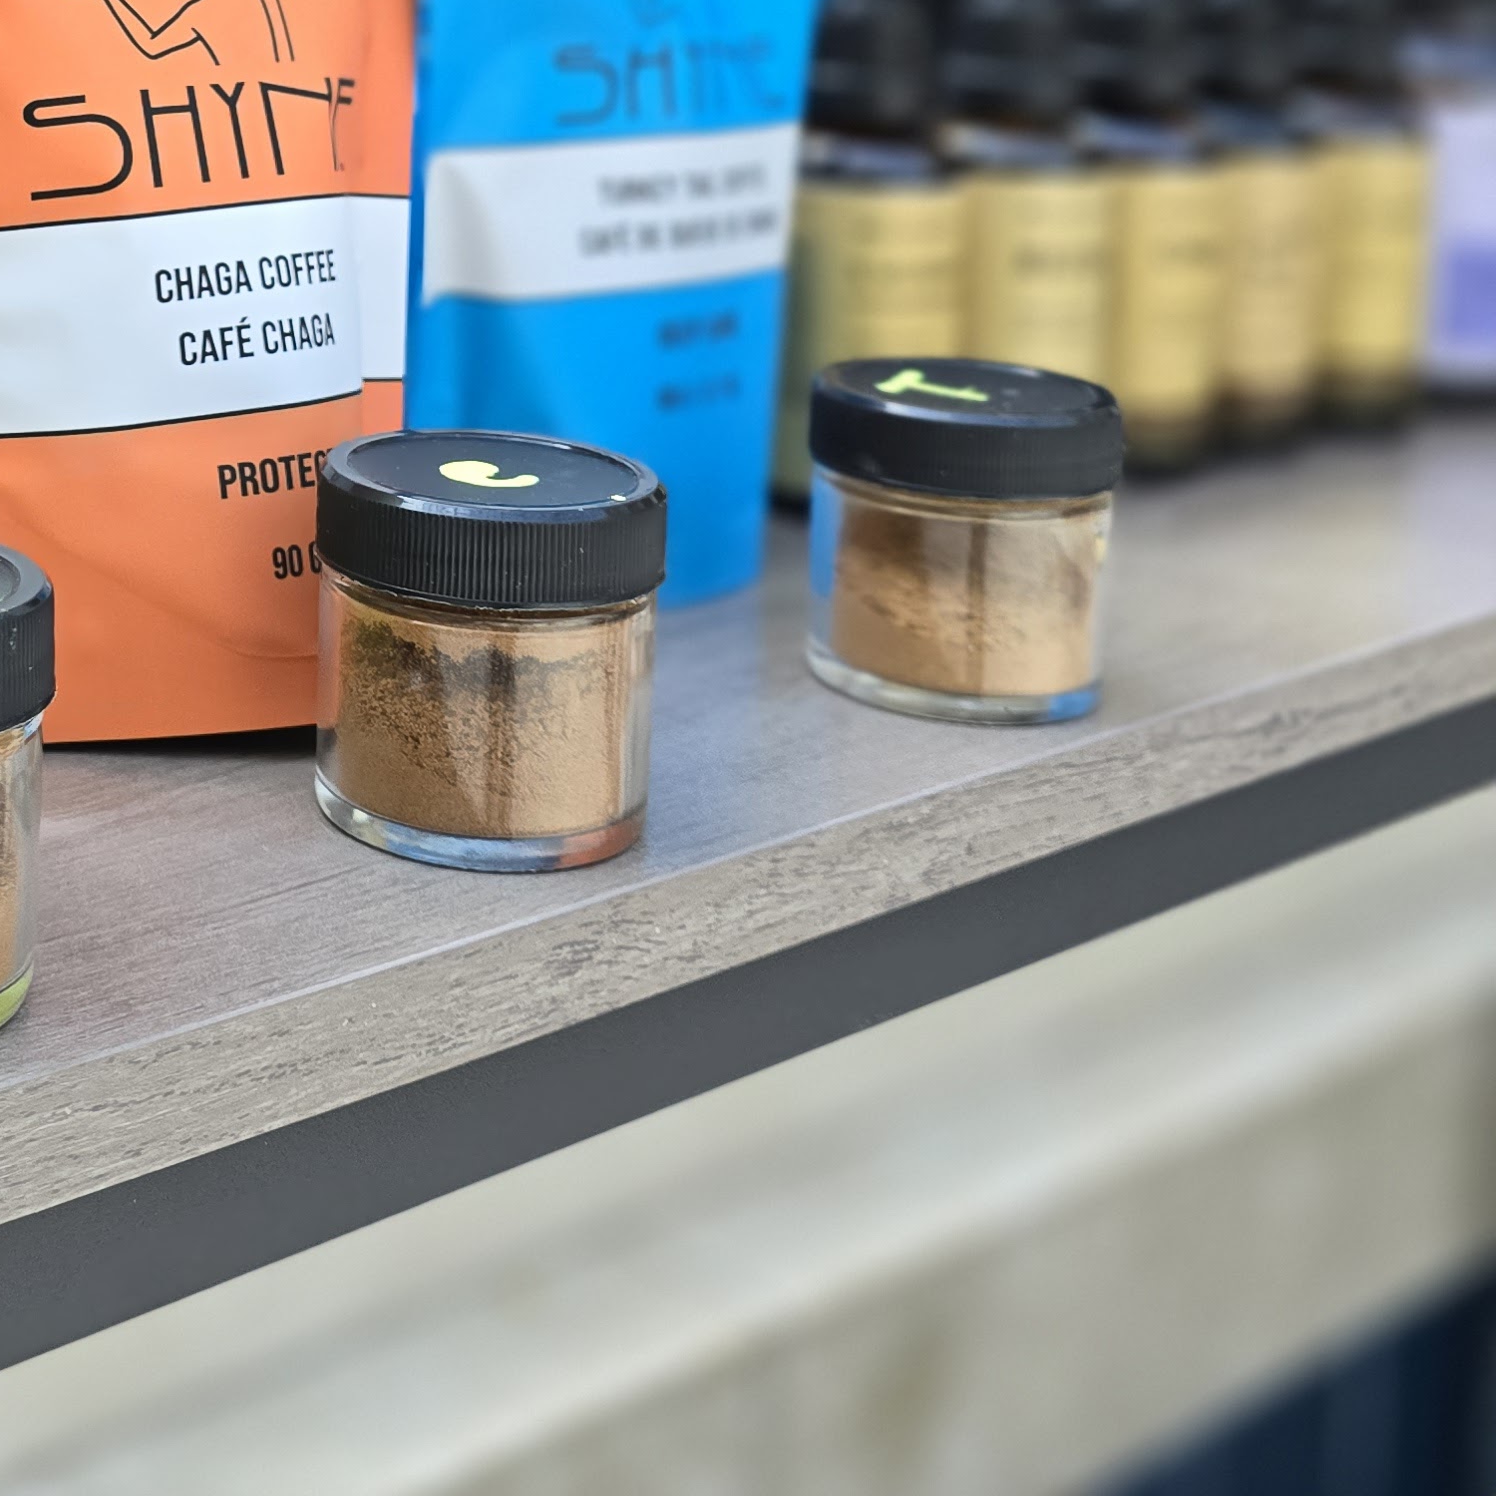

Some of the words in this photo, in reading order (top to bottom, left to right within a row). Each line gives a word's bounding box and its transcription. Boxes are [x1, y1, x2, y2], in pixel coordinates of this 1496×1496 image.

[154, 259, 254, 304] CHAGA
[259, 249, 336, 292] COFFEE
[178, 317, 255, 366] CAFÉ
[262, 313, 336, 356] CHAGA
[217, 448, 333, 500] PROTEC
[272, 544, 304, 580] 90
